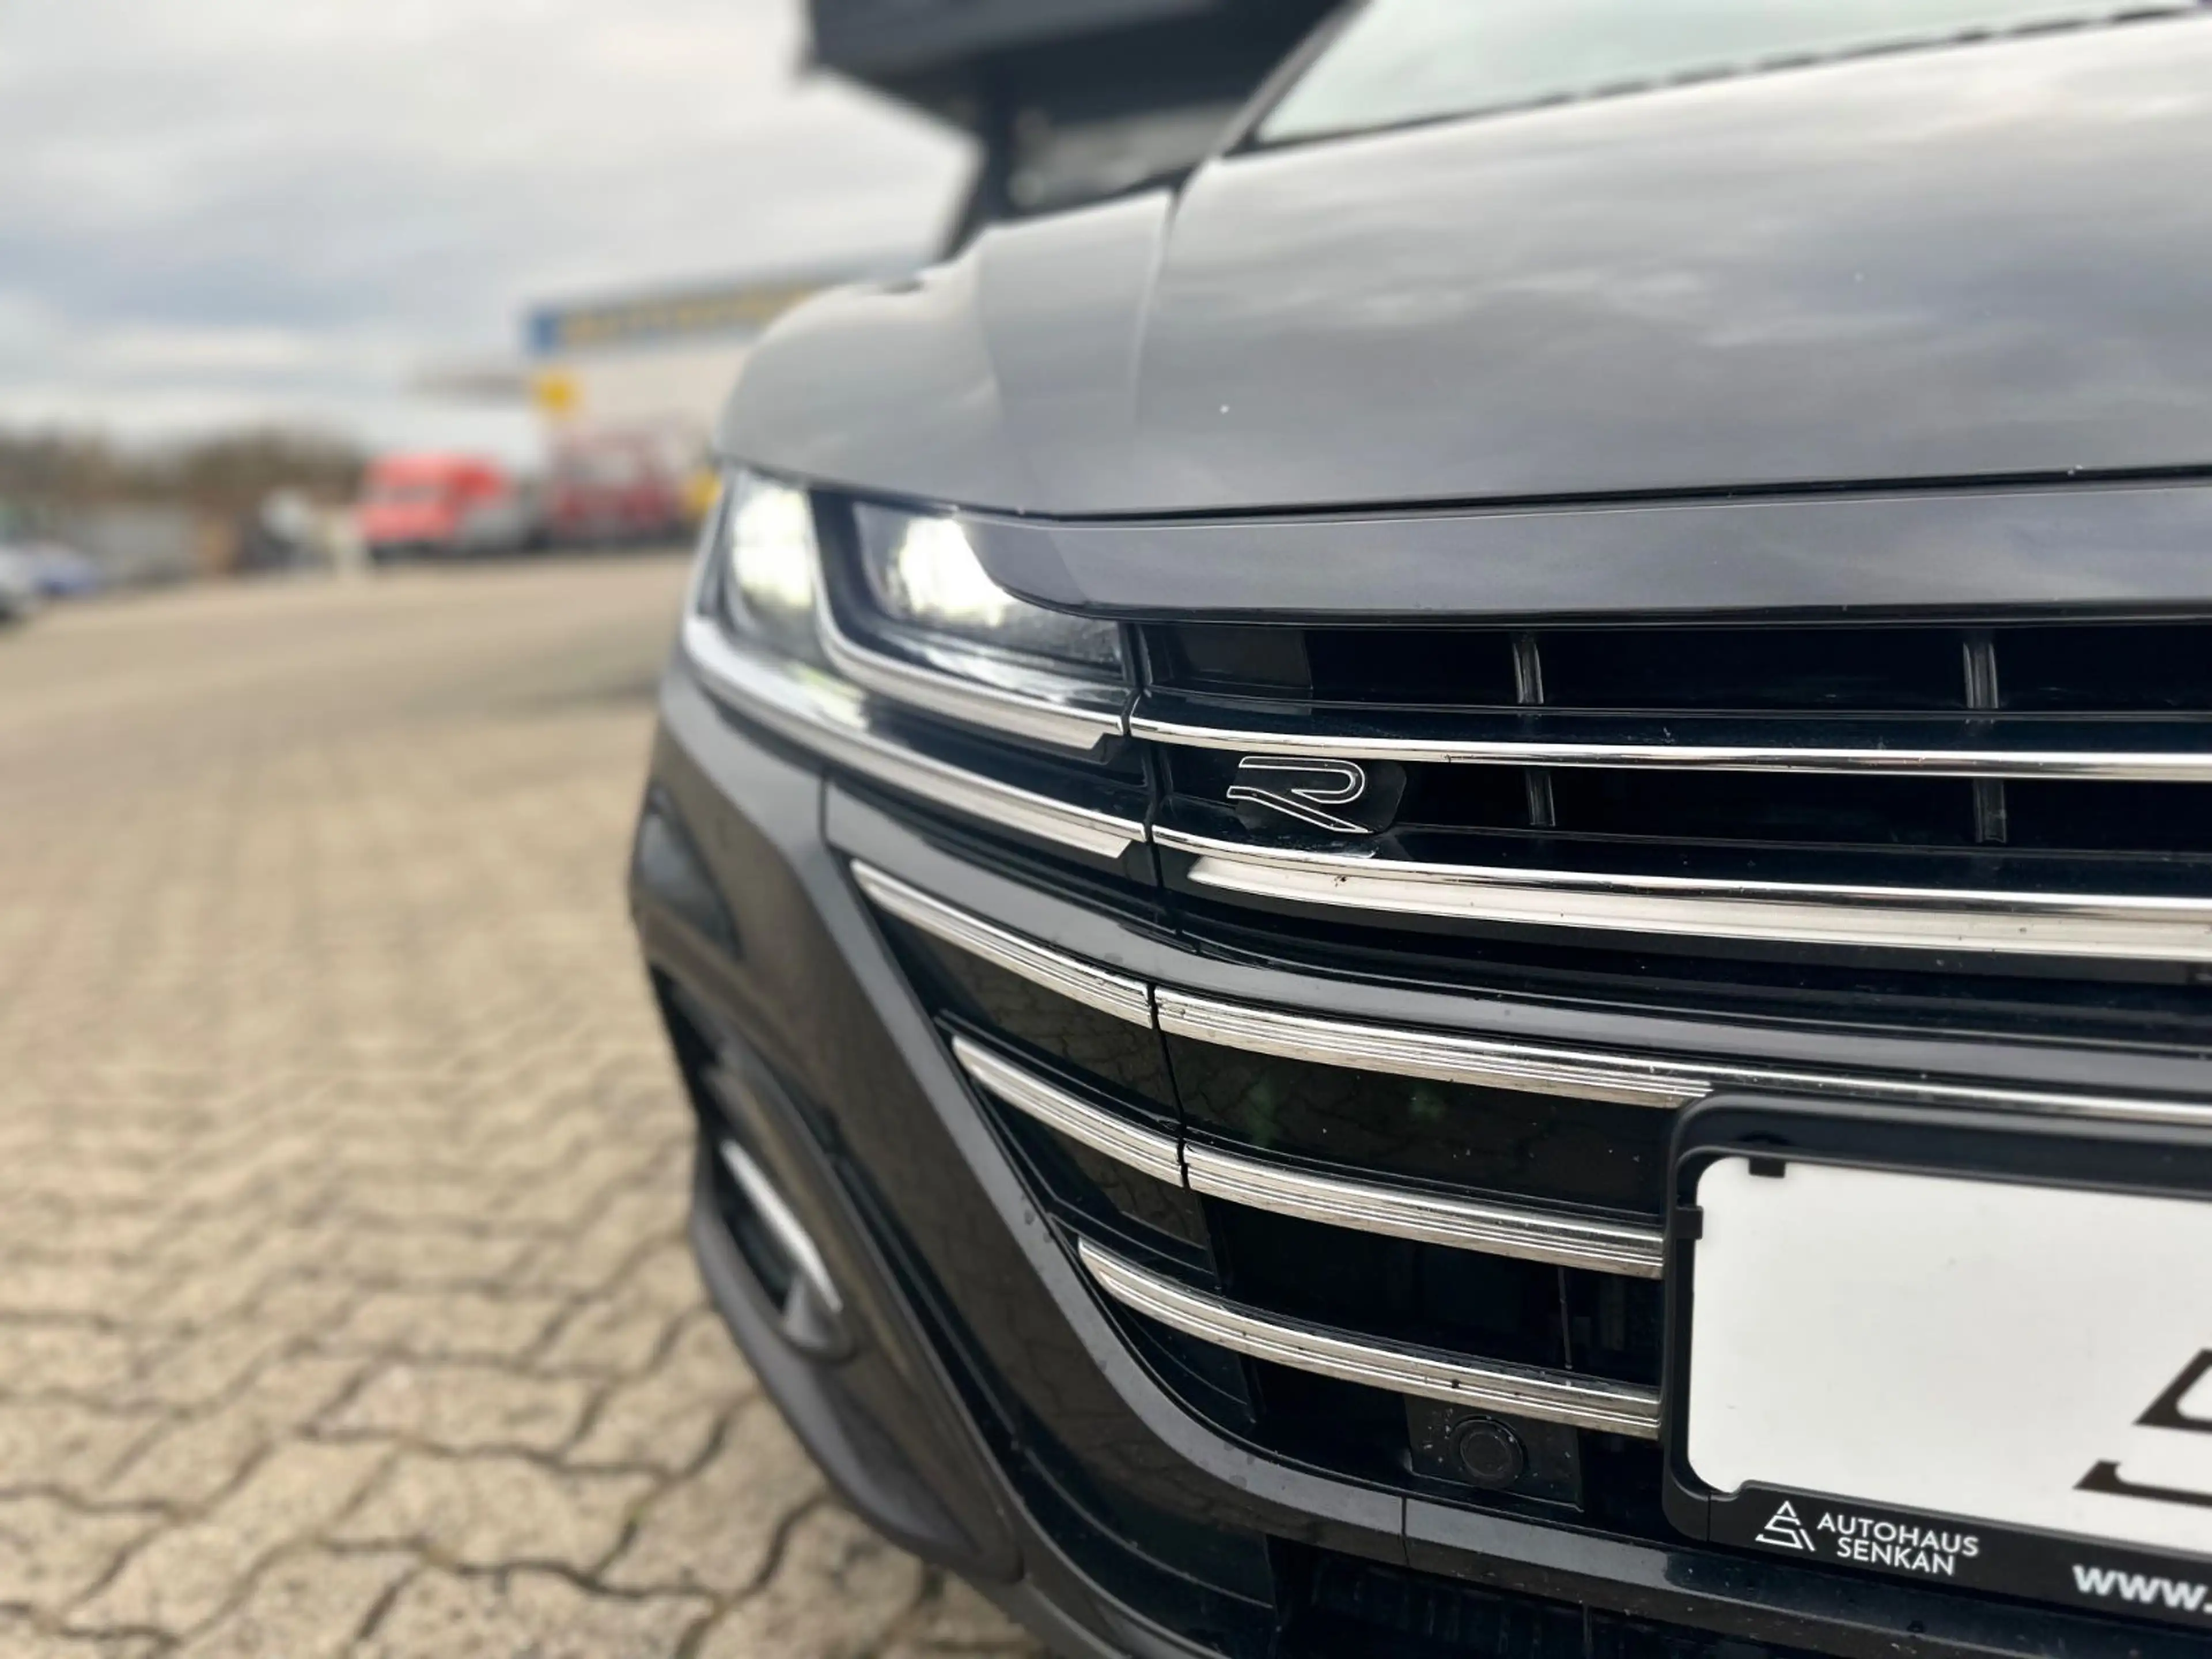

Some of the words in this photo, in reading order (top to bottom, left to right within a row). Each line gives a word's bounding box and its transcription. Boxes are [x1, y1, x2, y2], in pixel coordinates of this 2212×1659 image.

[1226, 756, 1374, 834] R
[1817, 1512, 1979, 1556] AUTOHAUS
[1837, 1537, 1955, 1575] SENKAN
